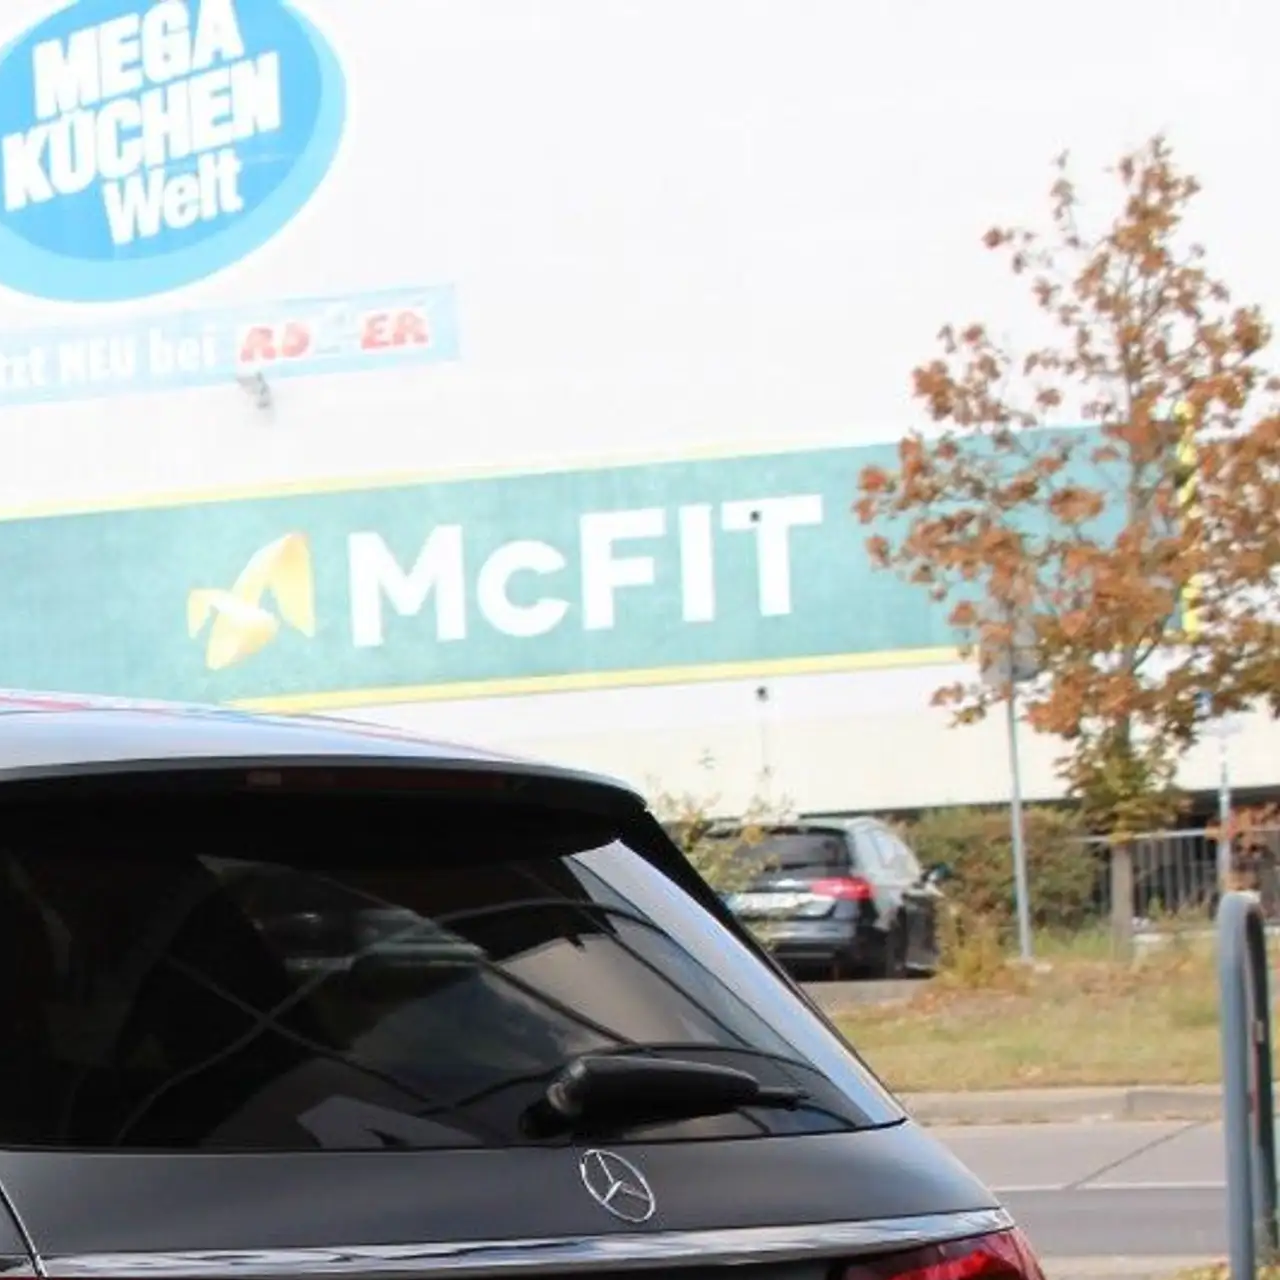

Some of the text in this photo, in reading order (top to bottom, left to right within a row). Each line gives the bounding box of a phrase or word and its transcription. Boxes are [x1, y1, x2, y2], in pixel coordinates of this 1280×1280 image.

[32, 0, 244, 120] MEGA
[102, 148, 244, 245] Welt
[59, 336, 136, 383] NEU
[149, 328, 217, 373] bei
[347, 494, 824, 647] McFIT
